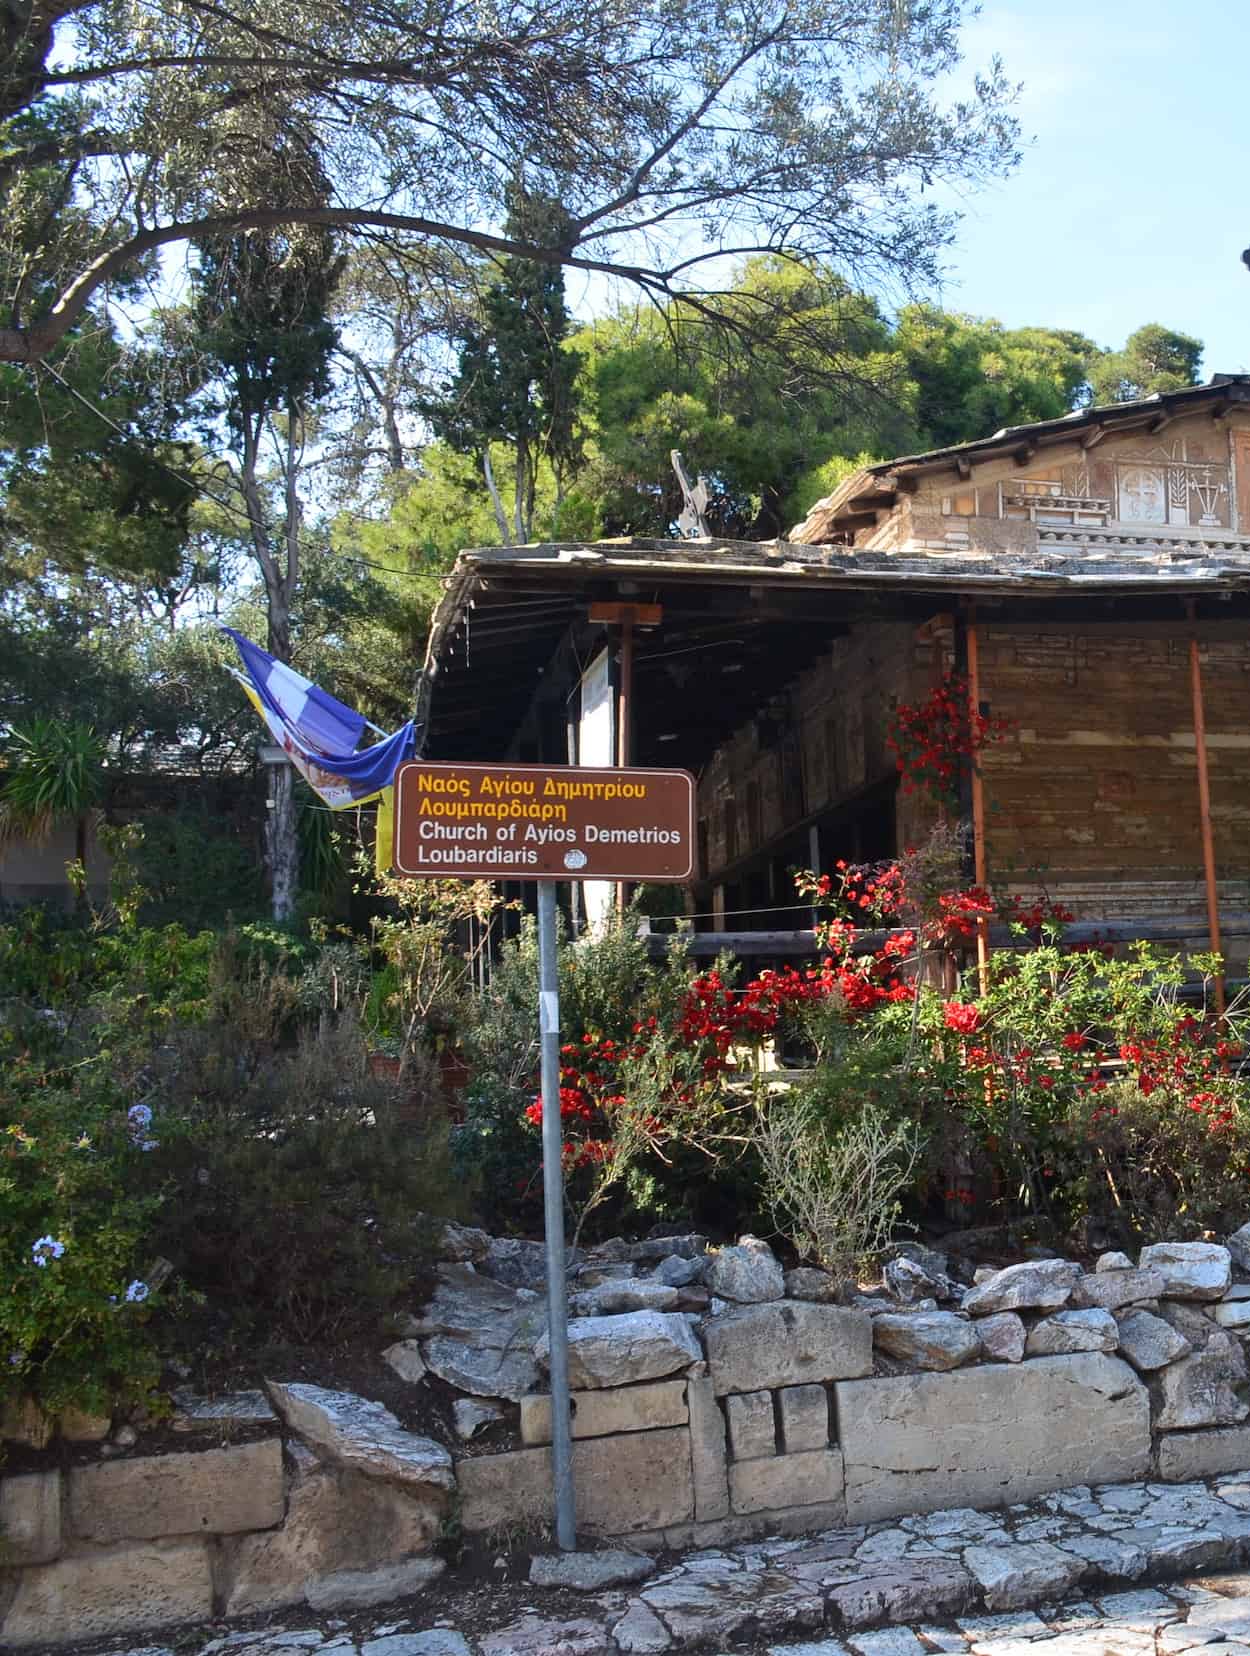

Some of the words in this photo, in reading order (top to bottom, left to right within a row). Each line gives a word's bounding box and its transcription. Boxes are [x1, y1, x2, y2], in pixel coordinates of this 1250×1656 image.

[418, 773, 470, 796] Ναός
[480, 775, 535, 798] Αγίου
[544, 778, 646, 800] Δημητρίου
[419, 798, 567, 822] Λουμπαρδιάρη
[419, 821, 487, 840] Church
[496, 824, 516, 841] of
[524, 825, 576, 845] Ayios
[585, 825, 680, 844] Demetrios
[418, 846, 537, 864] Loubardiaris
